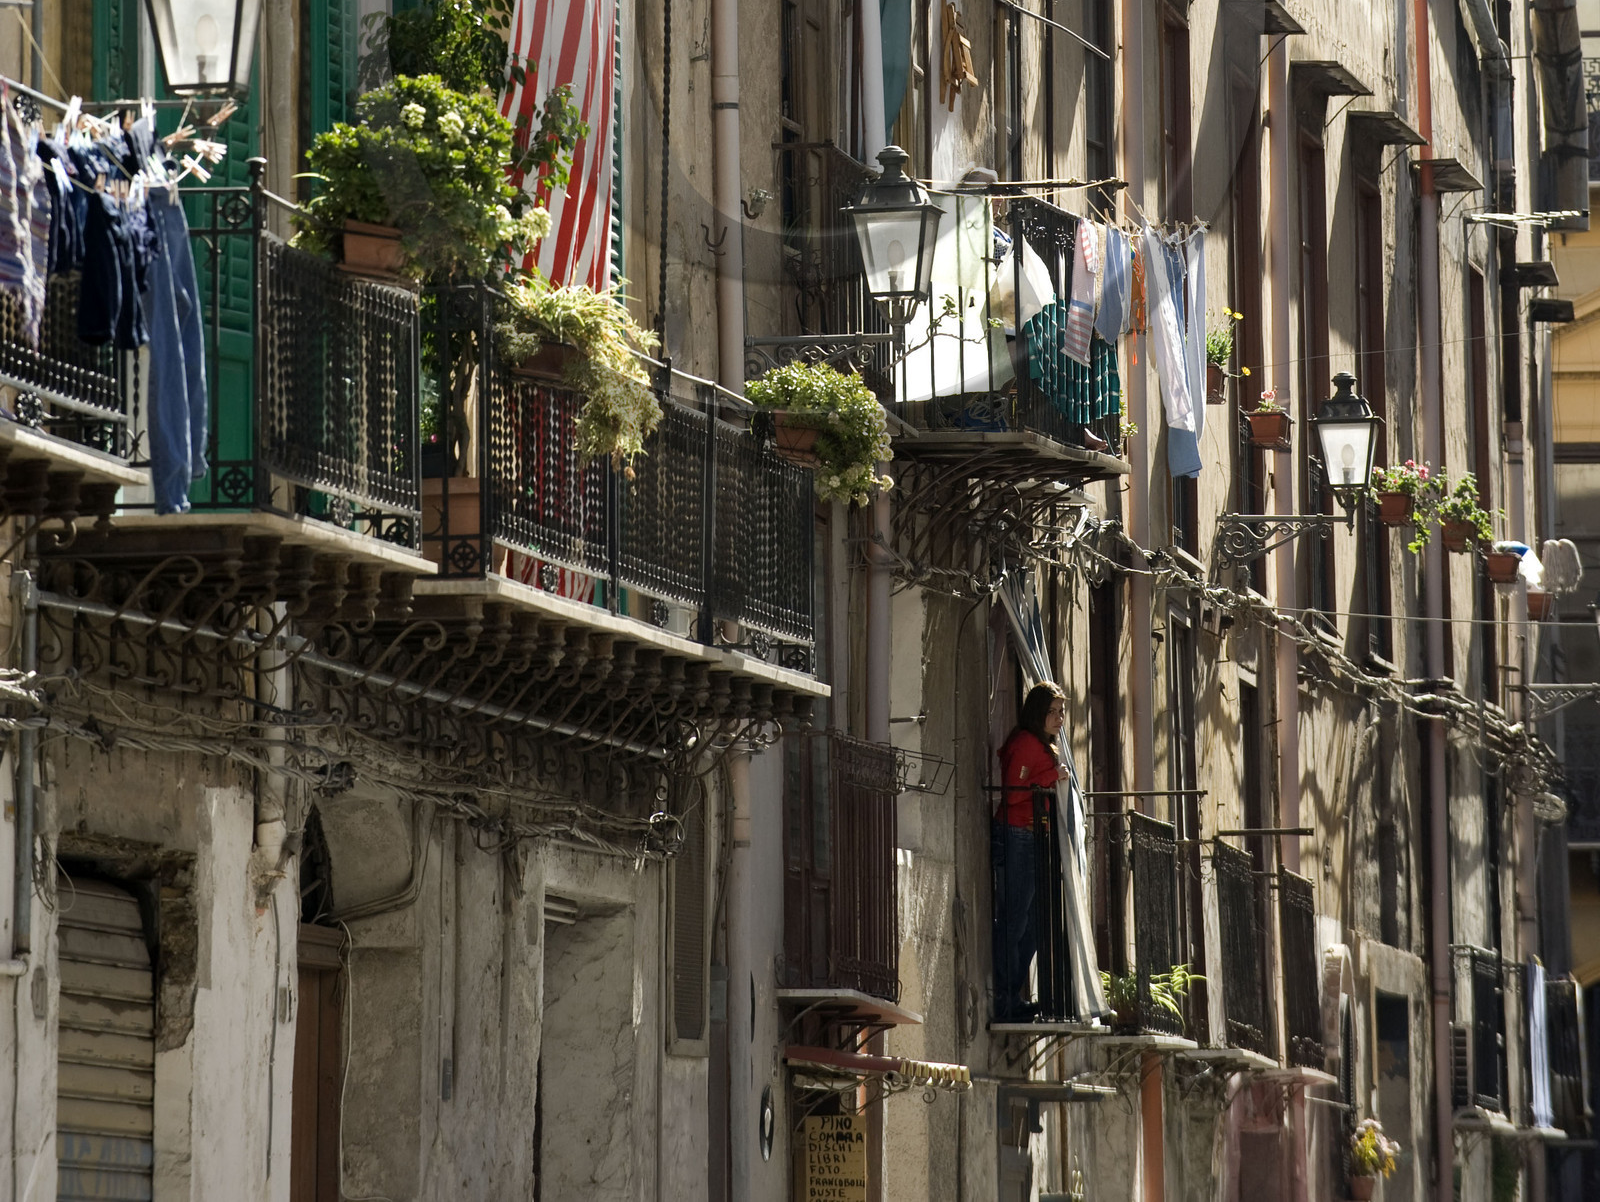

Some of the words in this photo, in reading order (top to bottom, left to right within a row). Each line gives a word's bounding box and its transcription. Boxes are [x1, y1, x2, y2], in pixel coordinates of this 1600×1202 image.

[809, 1142, 852, 1152] DISCHI
[809, 1153, 846, 1164] LIBRI
[810, 1165, 840, 1175] FOTO
[810, 1188, 846, 1198] BUSTE
